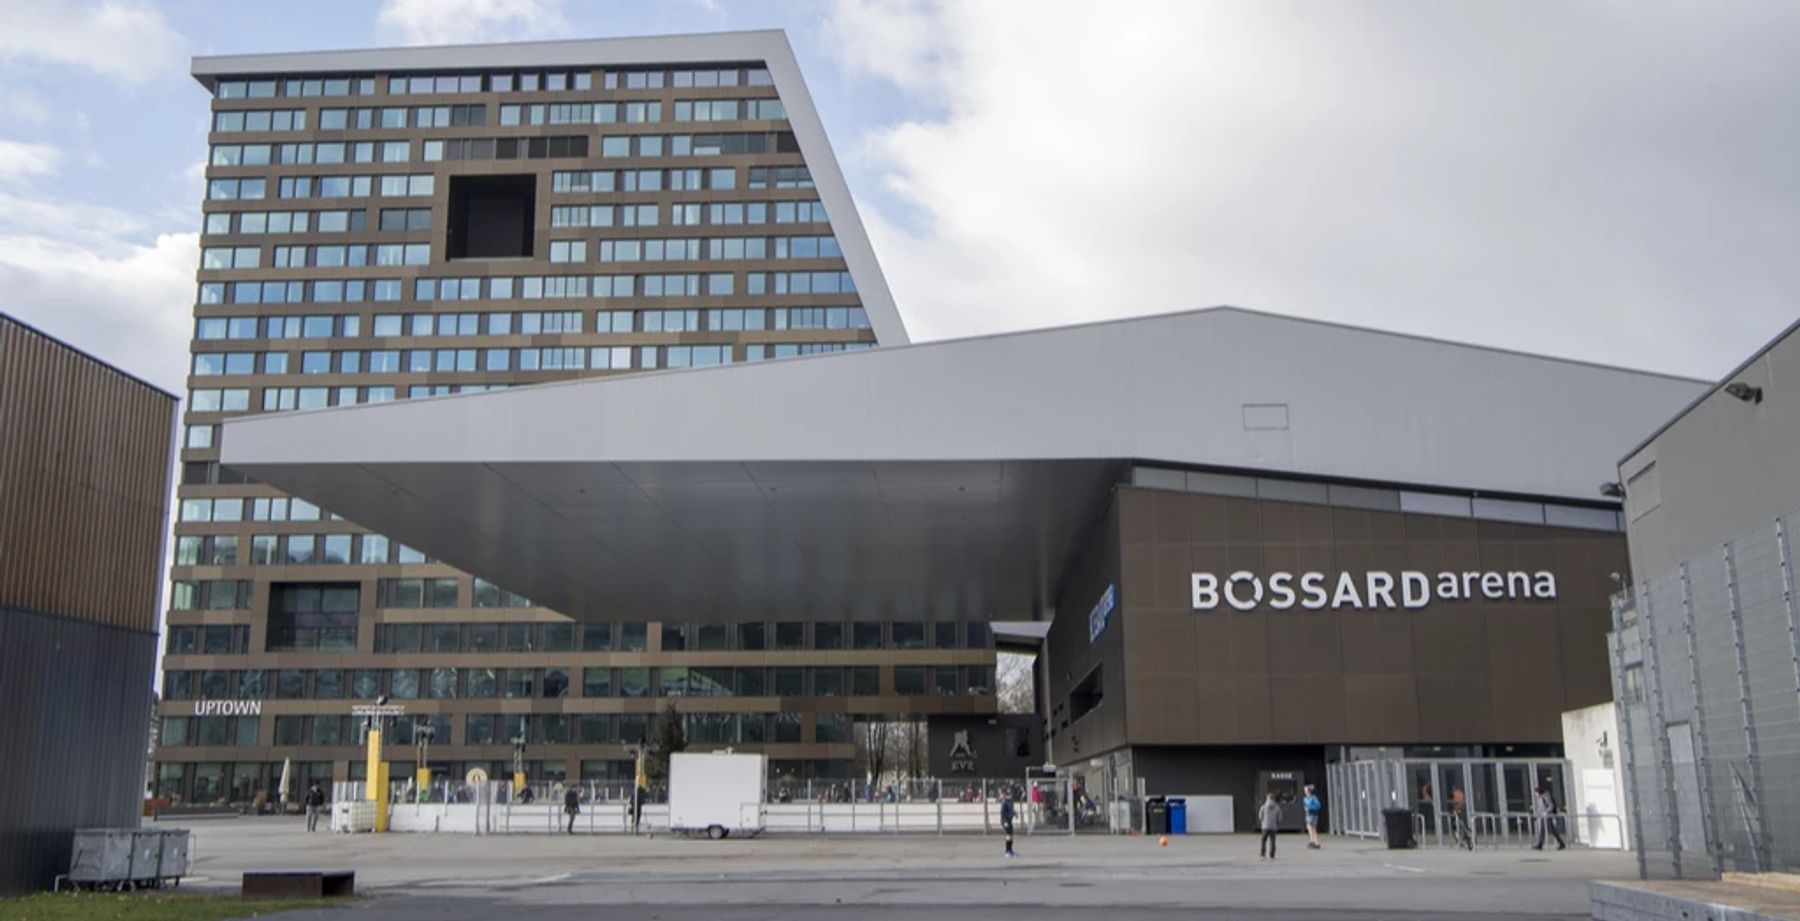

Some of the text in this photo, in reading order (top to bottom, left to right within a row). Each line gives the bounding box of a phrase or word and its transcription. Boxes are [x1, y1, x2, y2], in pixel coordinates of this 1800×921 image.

[1191, 571, 1557, 610] BOSSARD arena
[195, 700, 261, 716] UPTOWN
